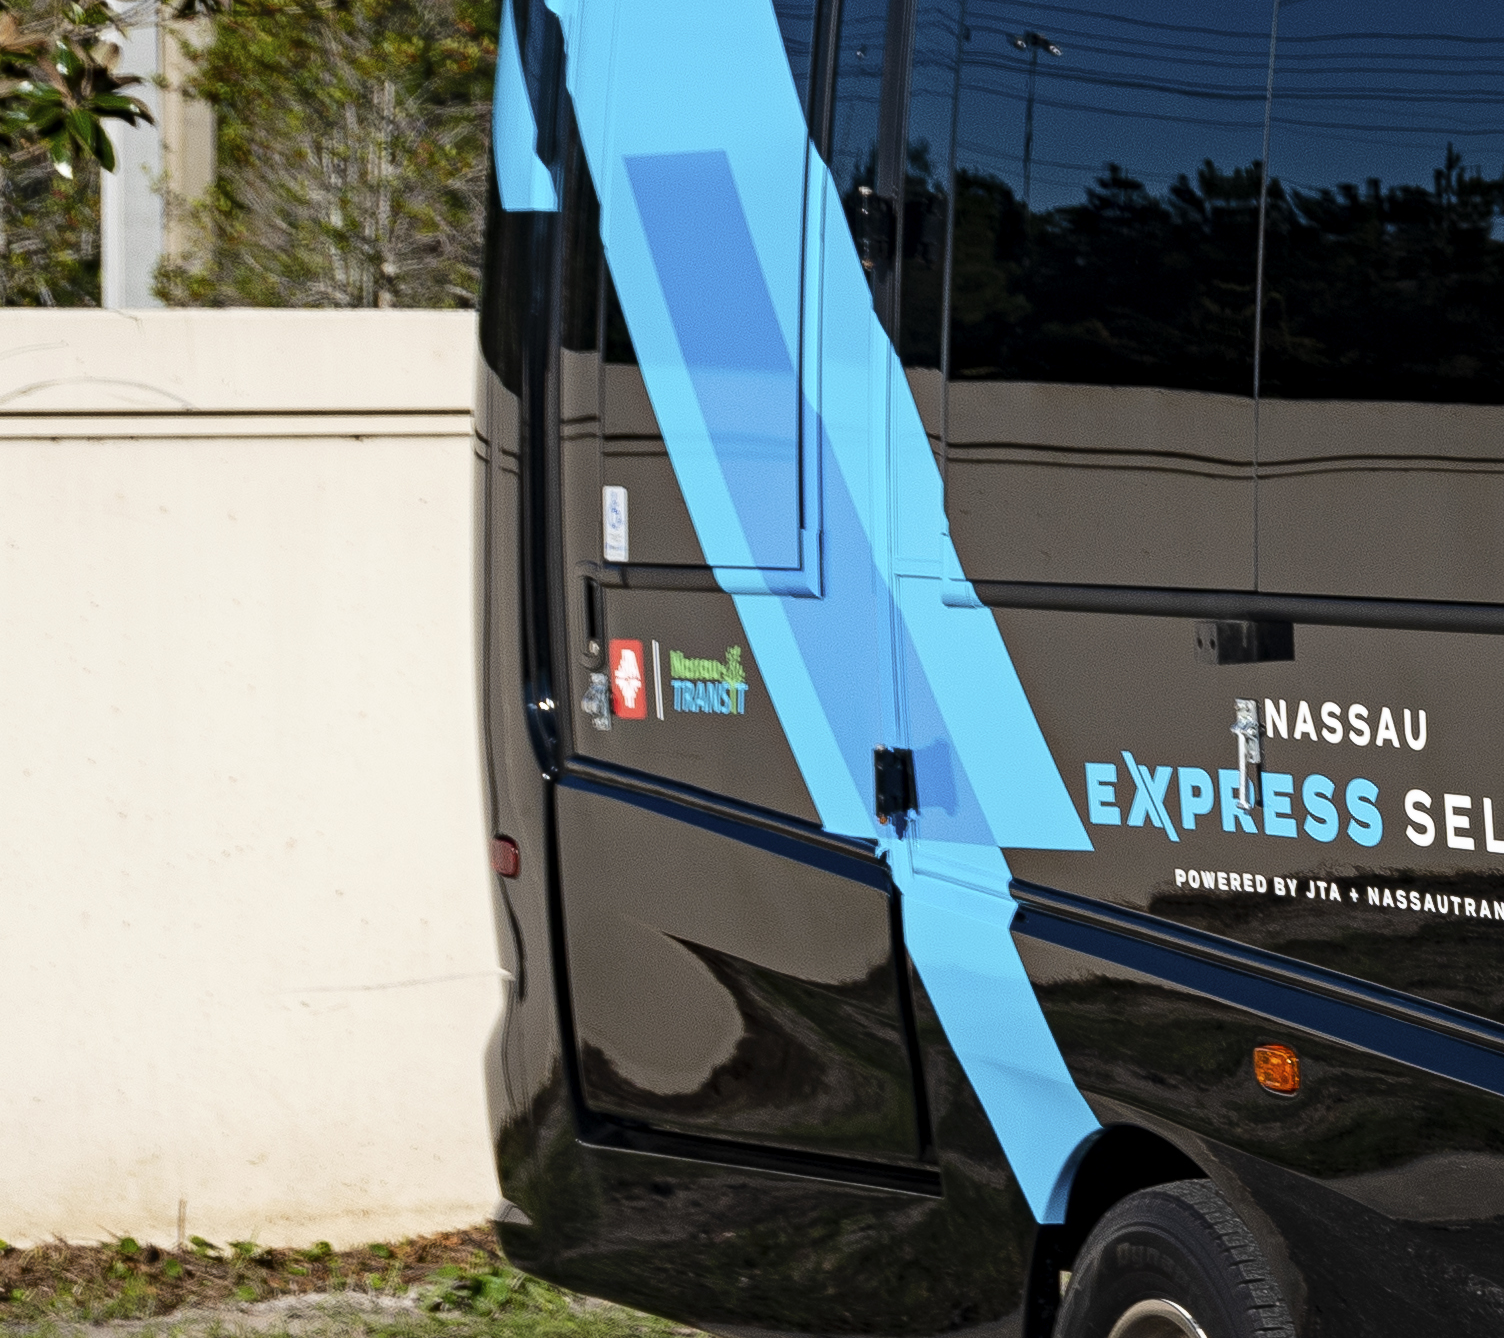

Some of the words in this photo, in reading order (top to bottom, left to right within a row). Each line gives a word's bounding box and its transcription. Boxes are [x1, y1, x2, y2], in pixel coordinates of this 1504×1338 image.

[1264, 697, 1428, 751] NASSAU
[1083, 751, 1384, 848] EXPRESS
[1174, 868, 1268, 895] POWERED
[1273, 877, 1298, 899] BY
[1305, 880, 1342, 903] JTA
[1349, 887, 1359, 903] +
